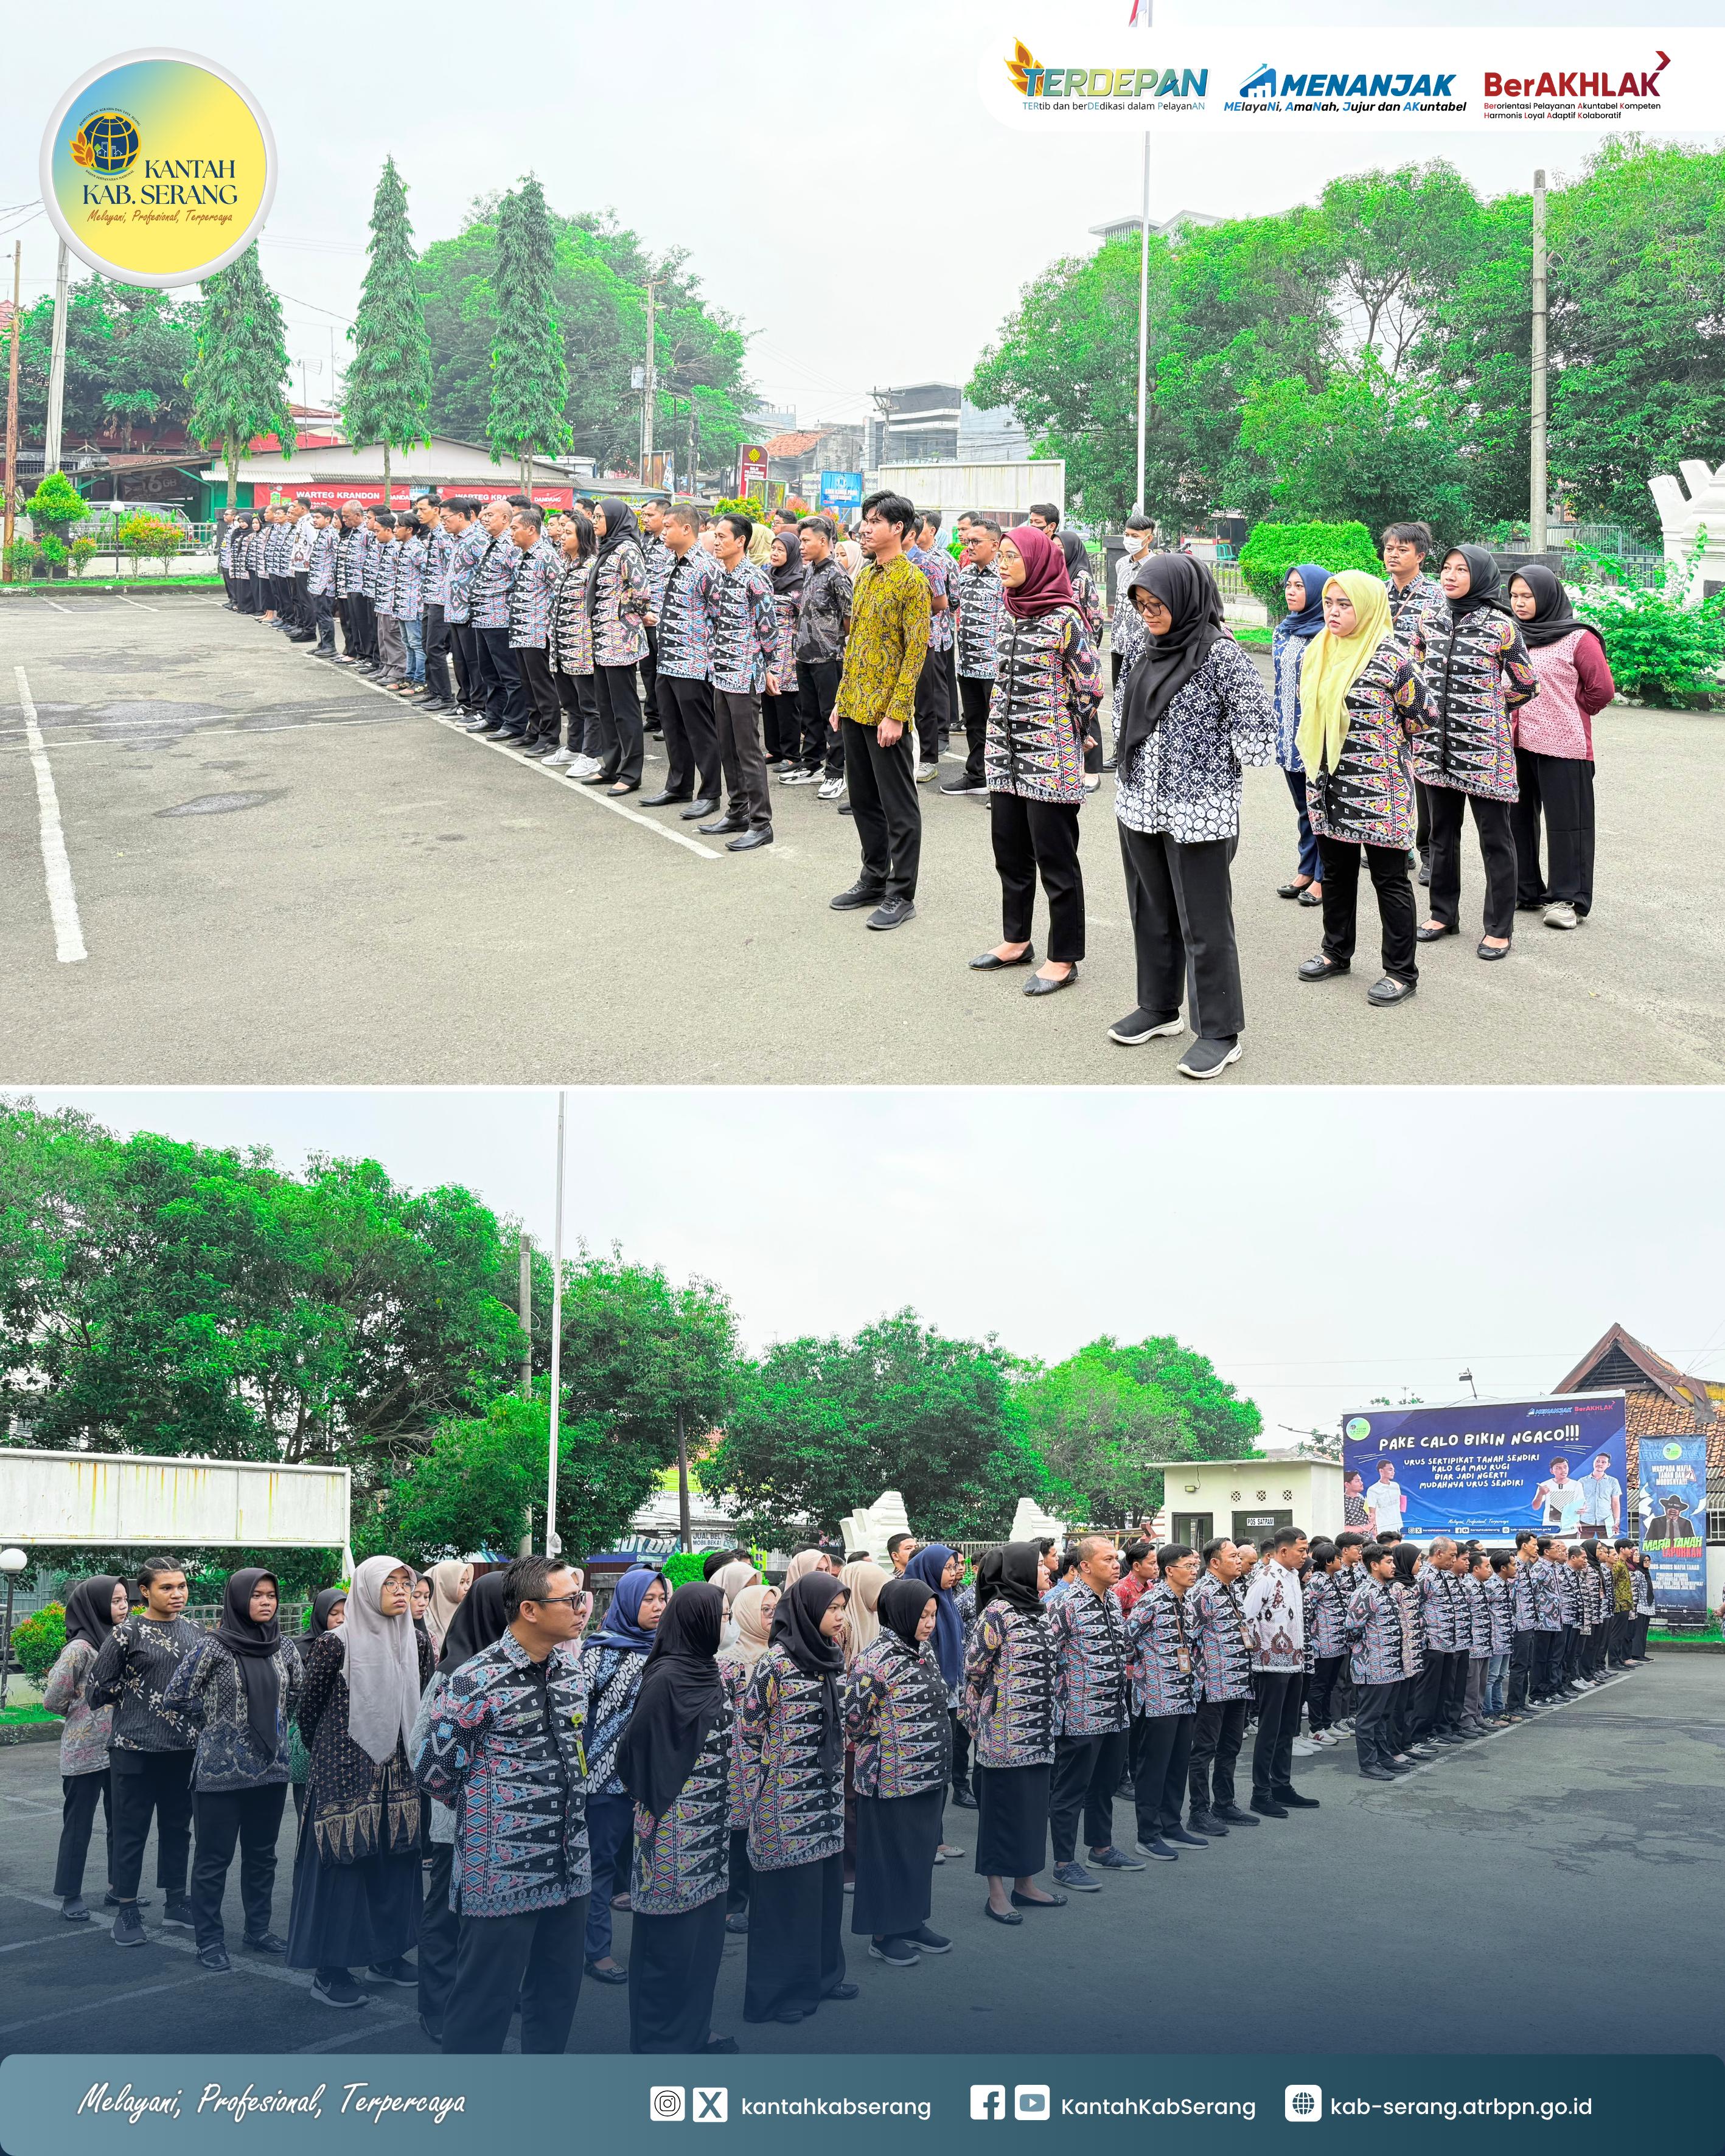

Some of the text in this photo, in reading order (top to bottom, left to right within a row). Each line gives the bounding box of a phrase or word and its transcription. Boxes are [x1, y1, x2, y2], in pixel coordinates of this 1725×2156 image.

[1379, 1424, 1580, 1452] PAKE CALO BIKIN NGACO!!!
[1404, 1453, 1540, 1466] URUS SERTIPIKAT TANAH SENDIRI
[1432, 1464, 1452, 1473] KALO
[1490, 1462, 1510, 1471] RUGI
[1419, 1480, 1464, 1489] MUDAHNYA
[1642, 1536, 1703, 1551] MAFIA TANAH
